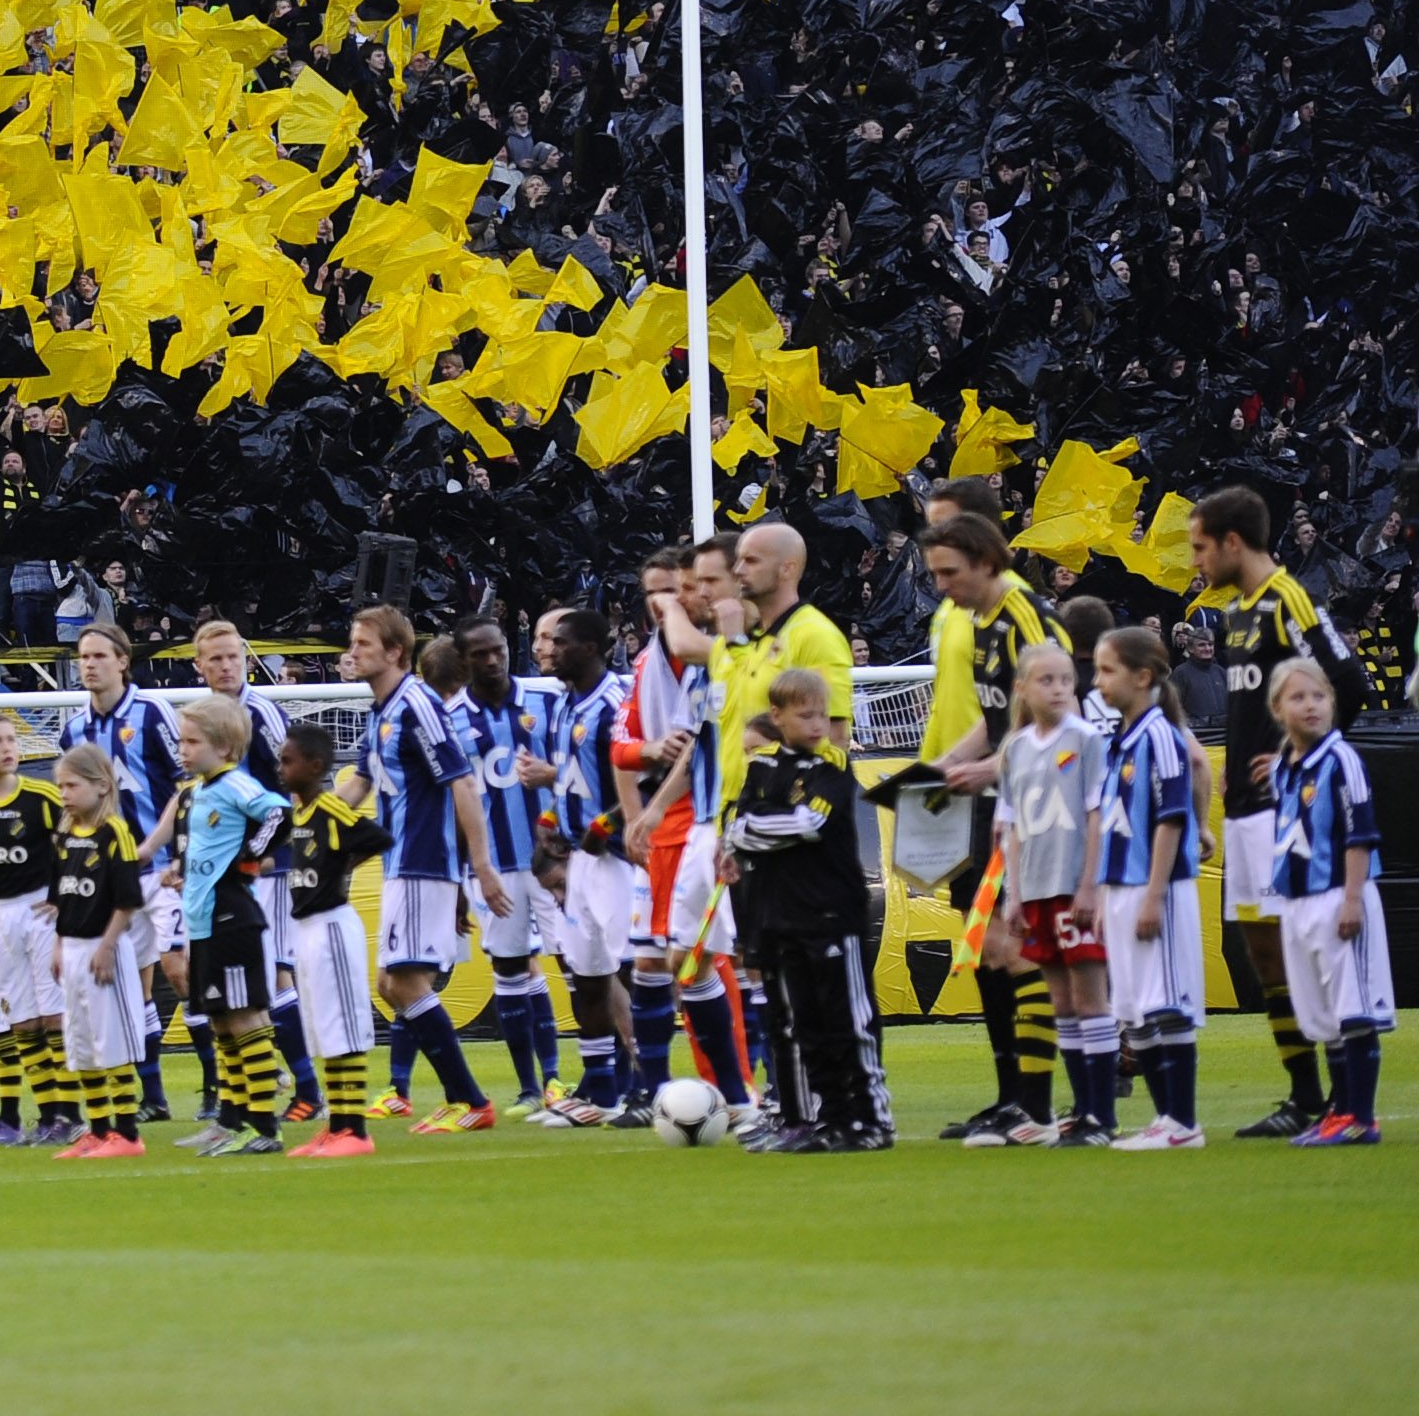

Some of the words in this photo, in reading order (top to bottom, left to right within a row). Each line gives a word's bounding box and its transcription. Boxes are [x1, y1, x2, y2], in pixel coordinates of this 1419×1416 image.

[414, 725, 443, 778] stadium
[388, 923, 399, 952] 6
[1054, 911, 1082, 950] 5
